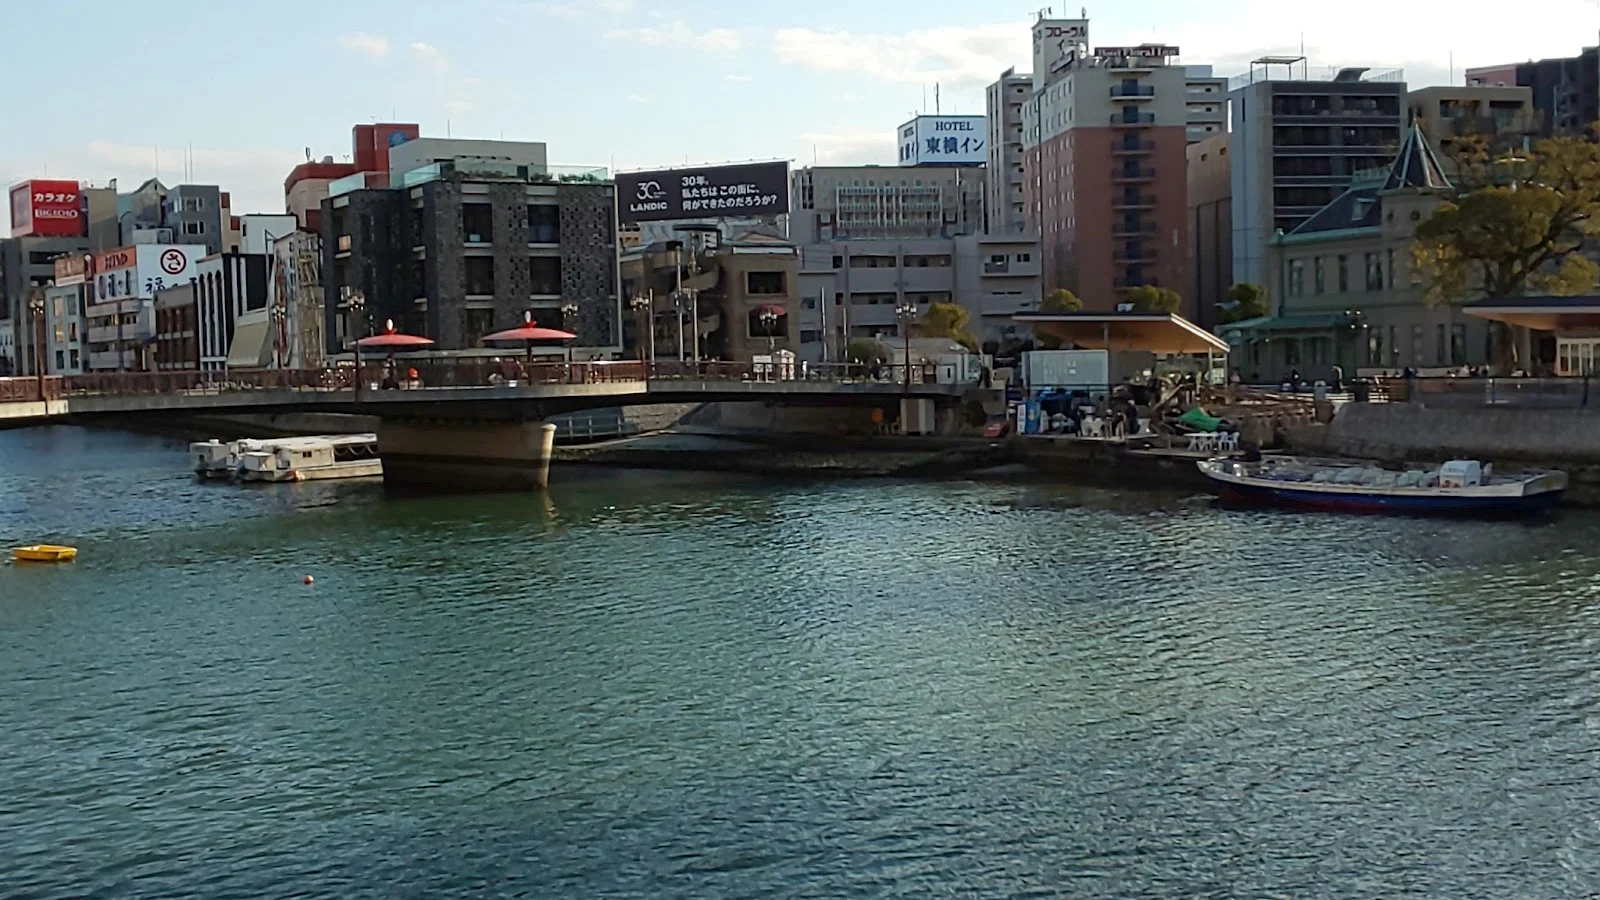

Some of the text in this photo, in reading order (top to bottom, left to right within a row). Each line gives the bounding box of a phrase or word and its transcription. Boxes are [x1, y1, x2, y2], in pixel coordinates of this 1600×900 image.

[936, 122, 973, 130] HOTEL
[926, 137, 984, 153] 東横イン
[637, 181, 661, 200] 30
[34, 192, 77, 203] カラオケ
[630, 202, 668, 212] LANDIC
[35, 209, 78, 219] BIG ECHO
